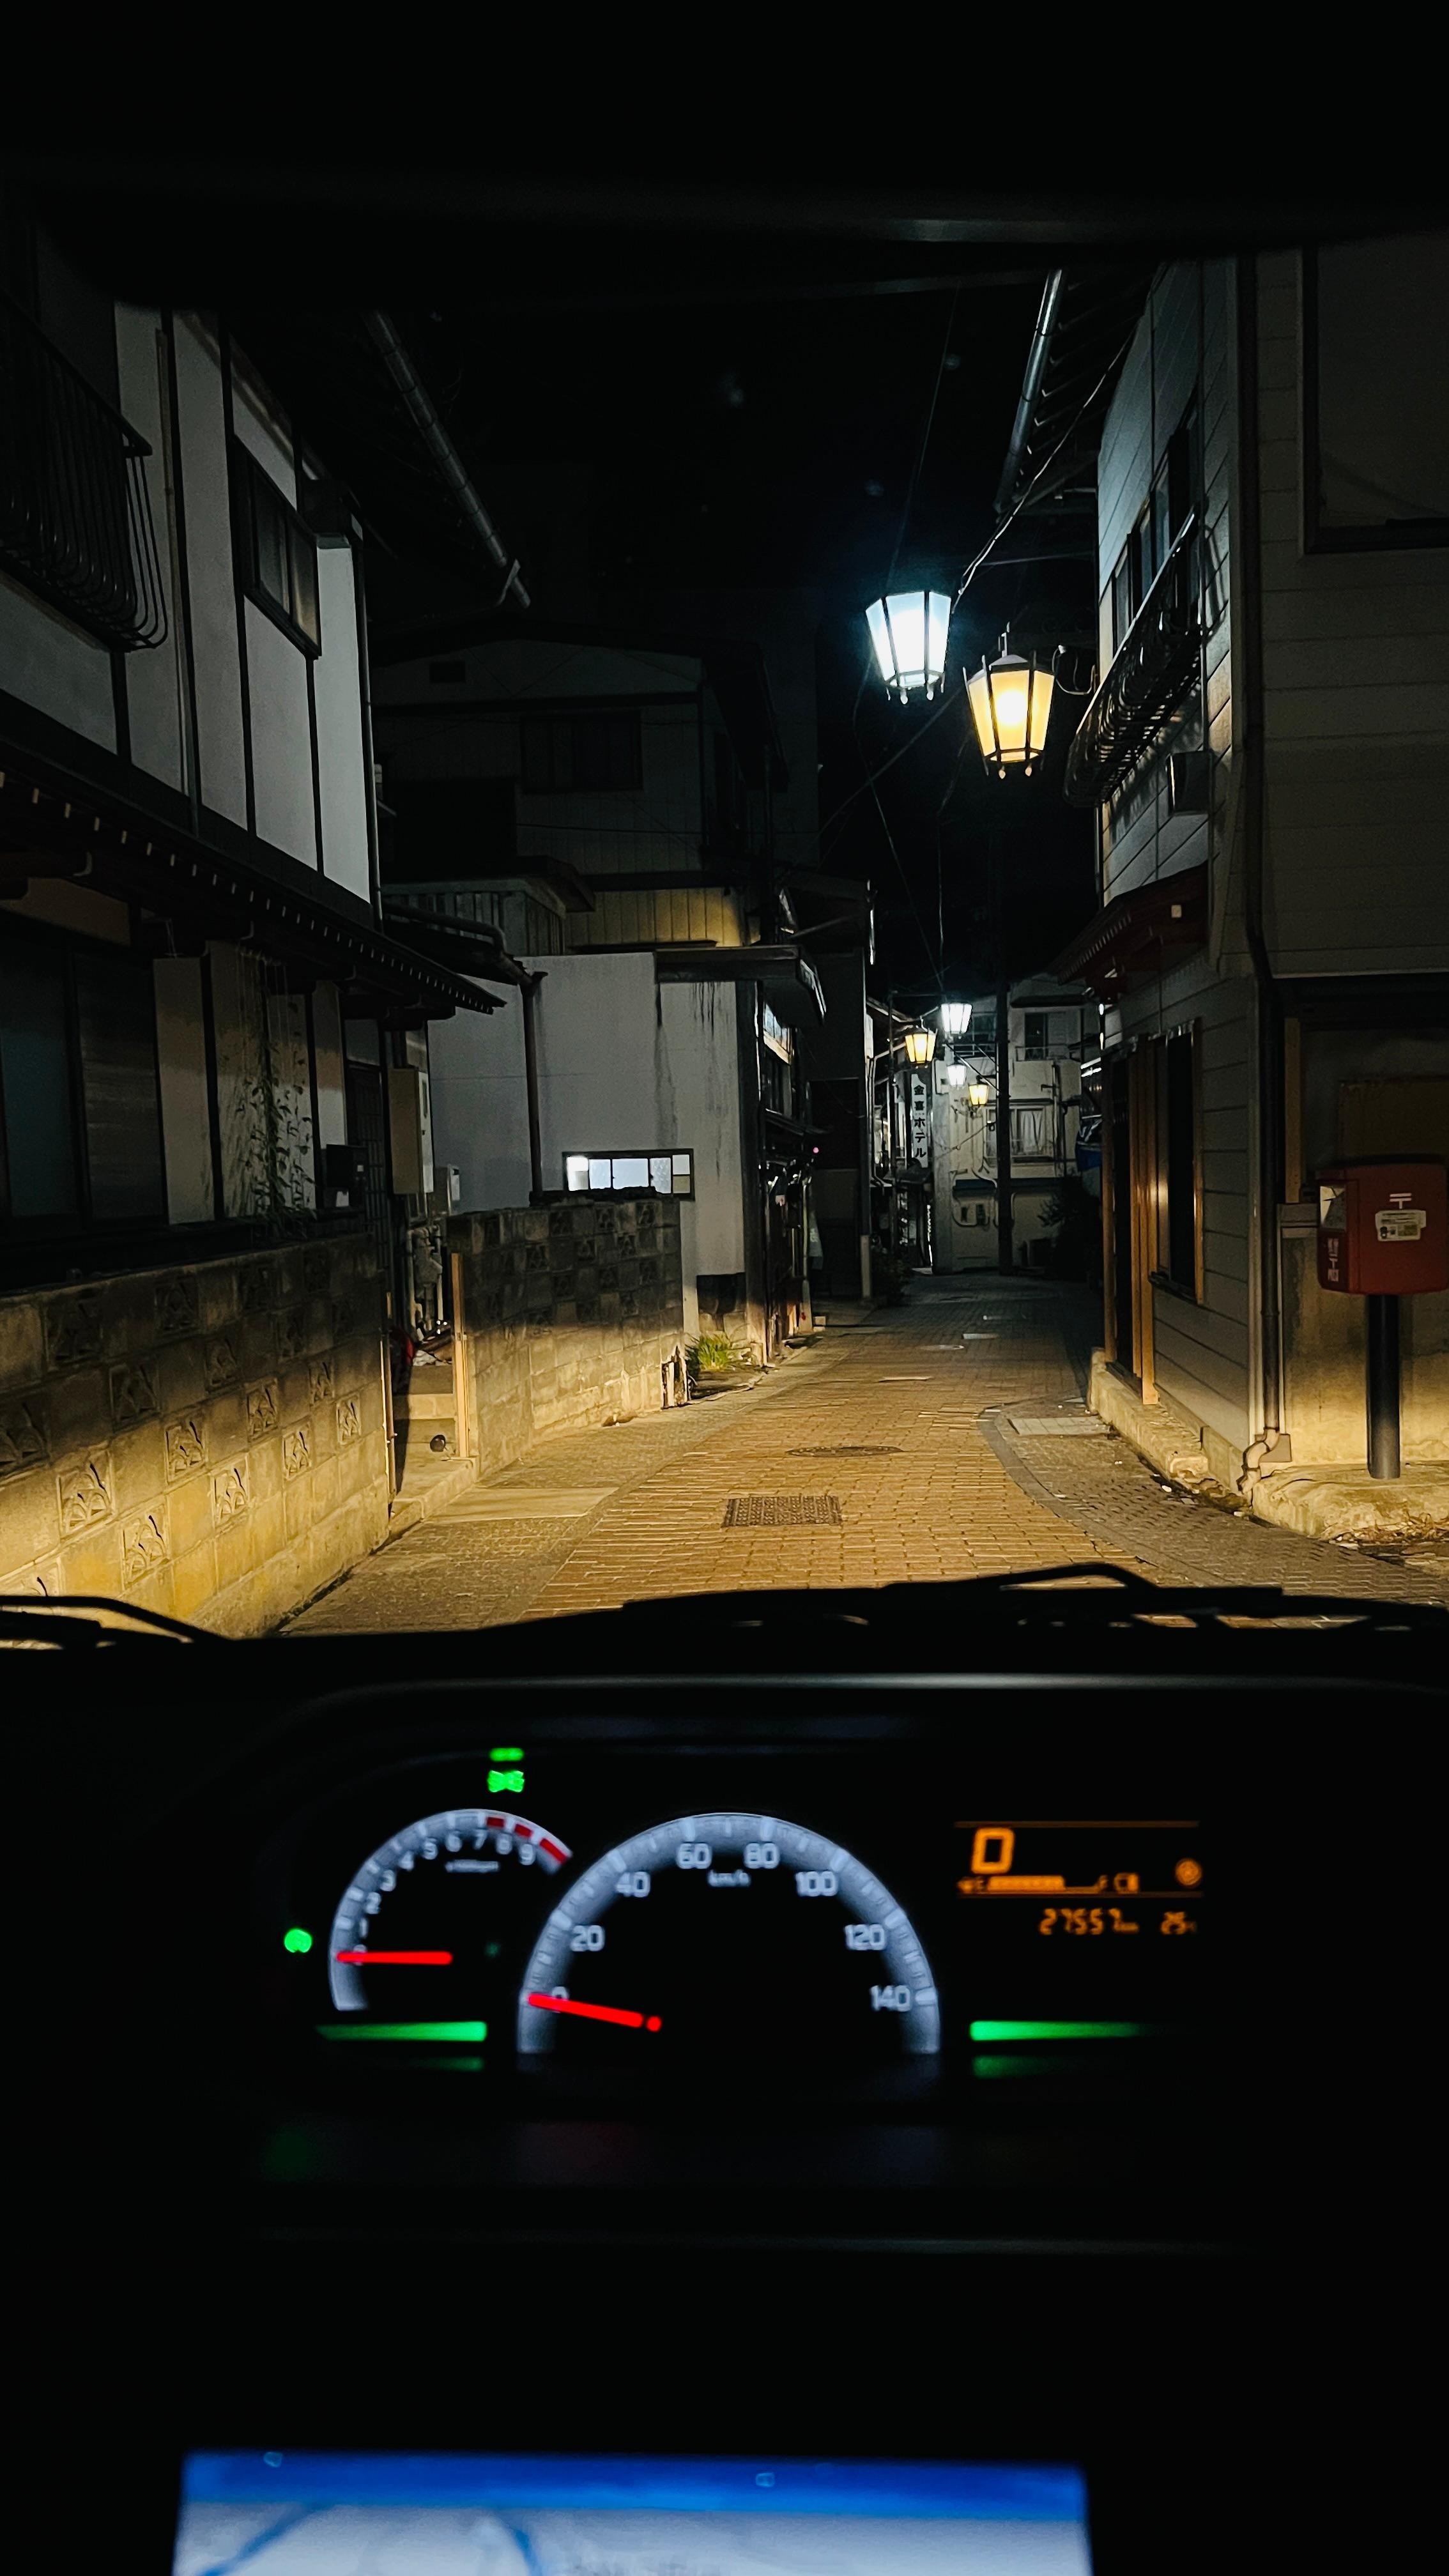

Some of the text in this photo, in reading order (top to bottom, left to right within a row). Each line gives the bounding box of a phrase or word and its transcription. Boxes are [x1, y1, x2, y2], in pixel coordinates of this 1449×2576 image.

[446, 1832, 462, 1852] 6
[496, 1834, 511, 1854] 8
[519, 1844, 535, 1865] 9
[676, 1843, 712, 1869] 60
[744, 1843, 779, 1869] 80
[616, 1871, 650, 1897] 40
[795, 1871, 838, 1897] 100
[571, 1924, 605, 1952] 20
[844, 1924, 886, 1951] 120
[870, 1985, 912, 2012] 140
